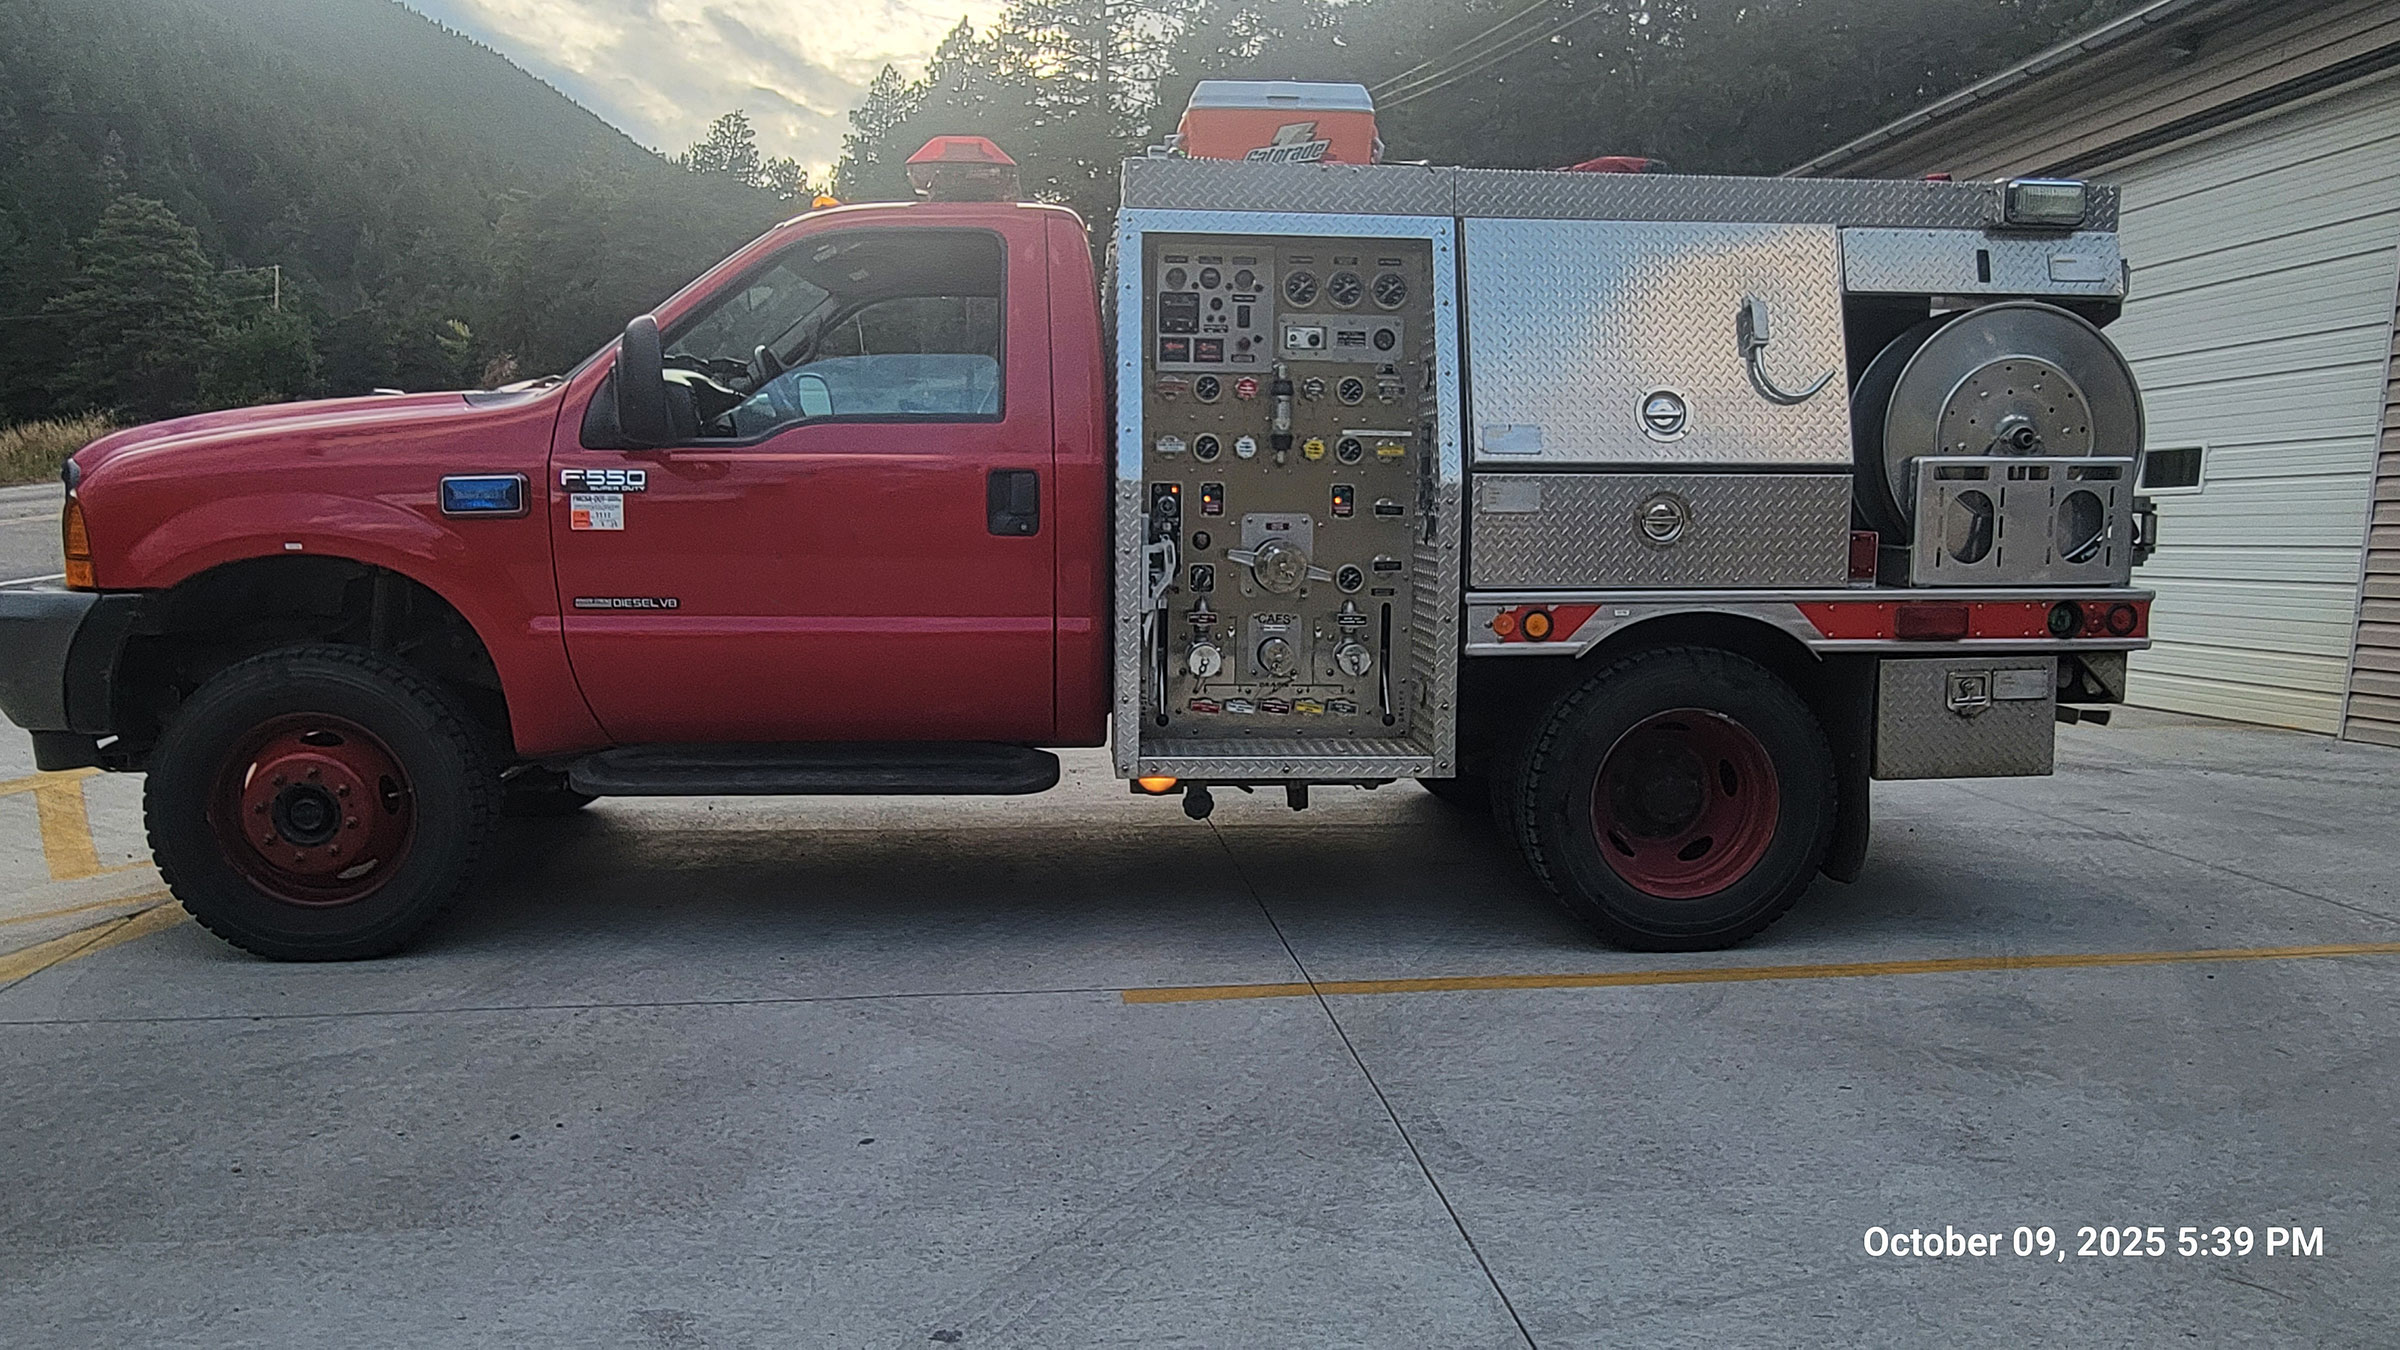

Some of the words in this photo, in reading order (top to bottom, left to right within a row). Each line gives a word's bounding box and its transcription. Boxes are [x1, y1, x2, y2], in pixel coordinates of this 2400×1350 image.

[1246, 142, 1326, 163] Gatorade
[561, 469, 646, 486] F-550
[613, 598, 660, 608] DIESEL
[660, 598, 678, 608] V8
